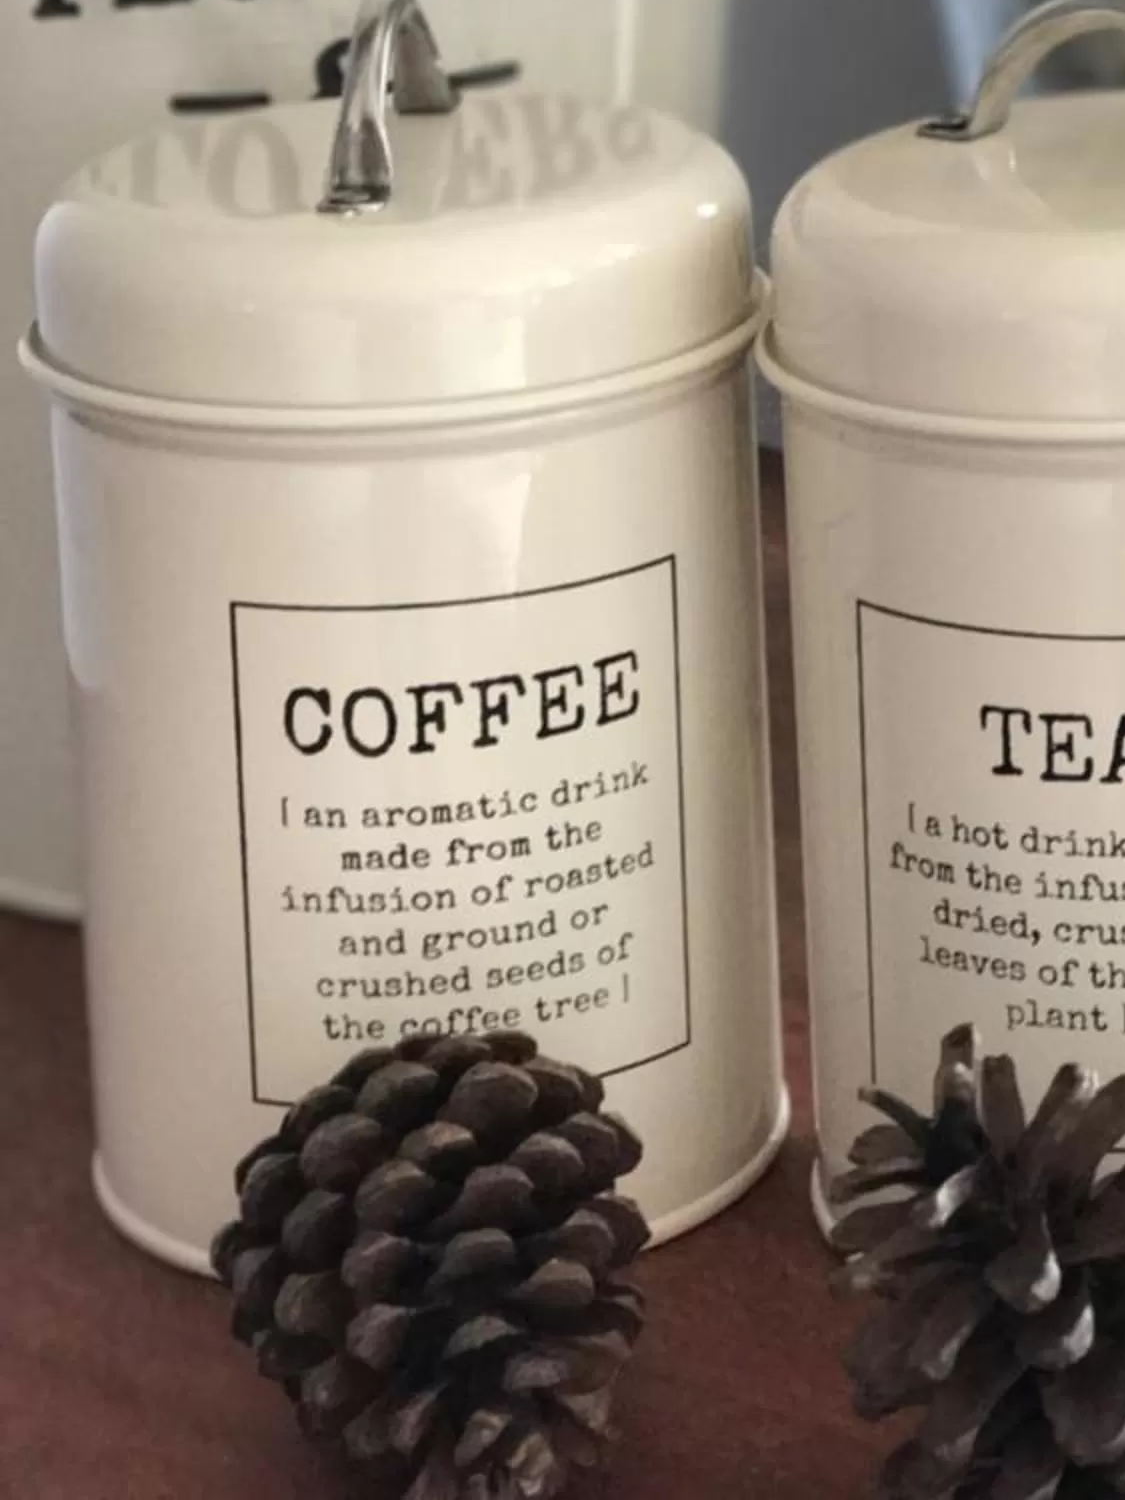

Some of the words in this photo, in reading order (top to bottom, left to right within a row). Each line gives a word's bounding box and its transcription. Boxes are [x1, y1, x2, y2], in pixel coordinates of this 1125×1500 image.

[284, 650, 639, 757] COFFEE
[362, 790, 538, 828] aromatic
[551, 761, 649, 806] drink
[341, 843, 430, 870] made
[447, 838, 531, 866] from
[546, 820, 602, 851] the
[952, 814, 1009, 851] hot
[282, 885, 456, 914] infusion
[471, 874, 513, 905] of
[525, 841, 654, 898] roasted
[890, 841, 955, 884] from
[966, 861, 1022, 894] the
[339, 928, 406, 956] and
[422, 910, 558, 960] ground
[570, 903, 608, 930] or
[933, 897, 1041, 946] dried,
[316, 966, 471, 999] crushed
[486, 950, 585, 989] seeds
[597, 932, 633, 966] of
[920, 935, 1026, 982] leaves
[1038, 959, 1079, 987] of
[323, 1013, 385, 1040] the
[400, 1005, 521, 1036] coffee
